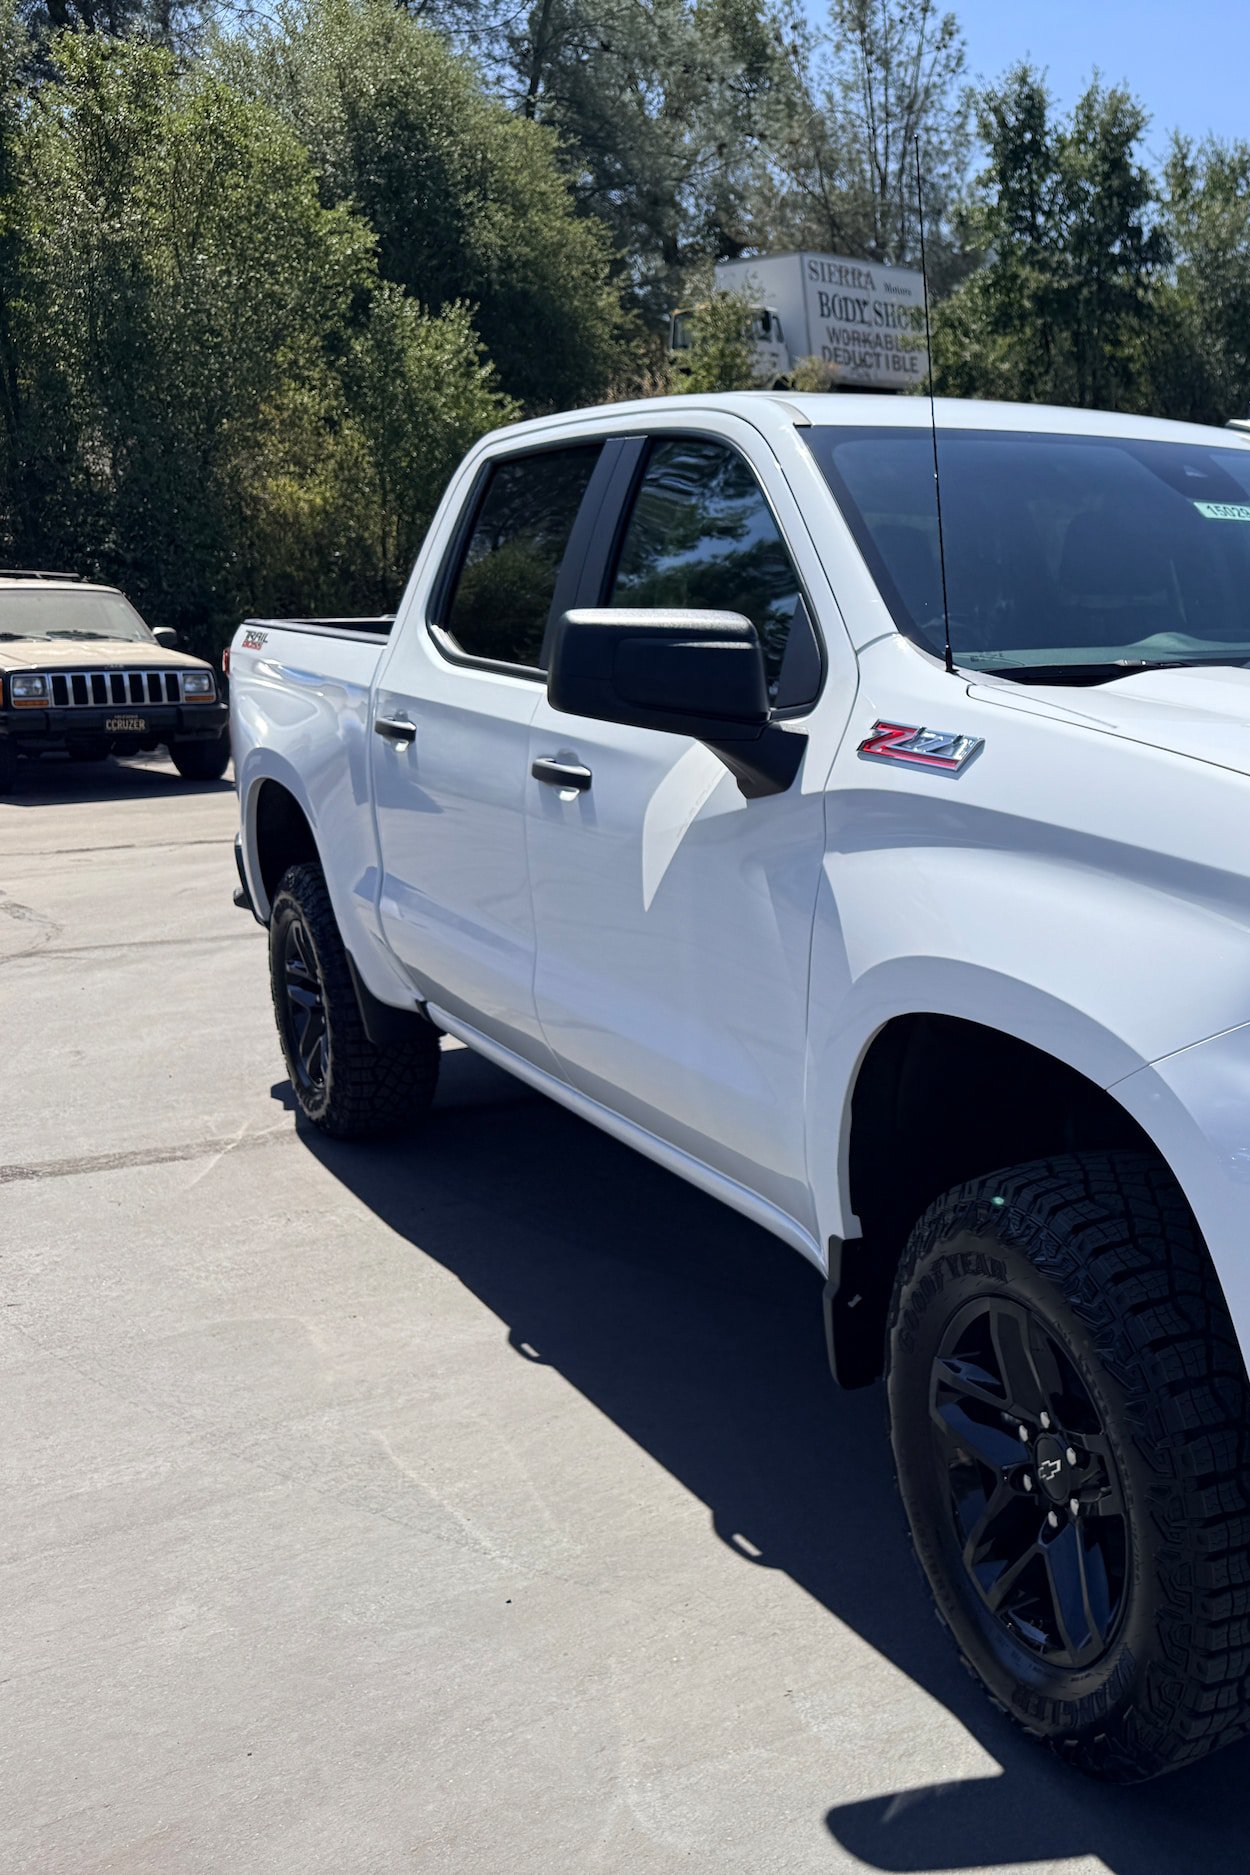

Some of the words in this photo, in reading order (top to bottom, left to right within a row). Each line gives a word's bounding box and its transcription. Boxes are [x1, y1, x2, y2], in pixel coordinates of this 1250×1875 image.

[808, 260, 876, 291] SIERRA
[818, 291, 872, 327] BODY
[821, 345, 920, 373] DEDUCTIBLE
[245, 630, 268, 643] TRAIL
[857, 718, 985, 772] Z71
